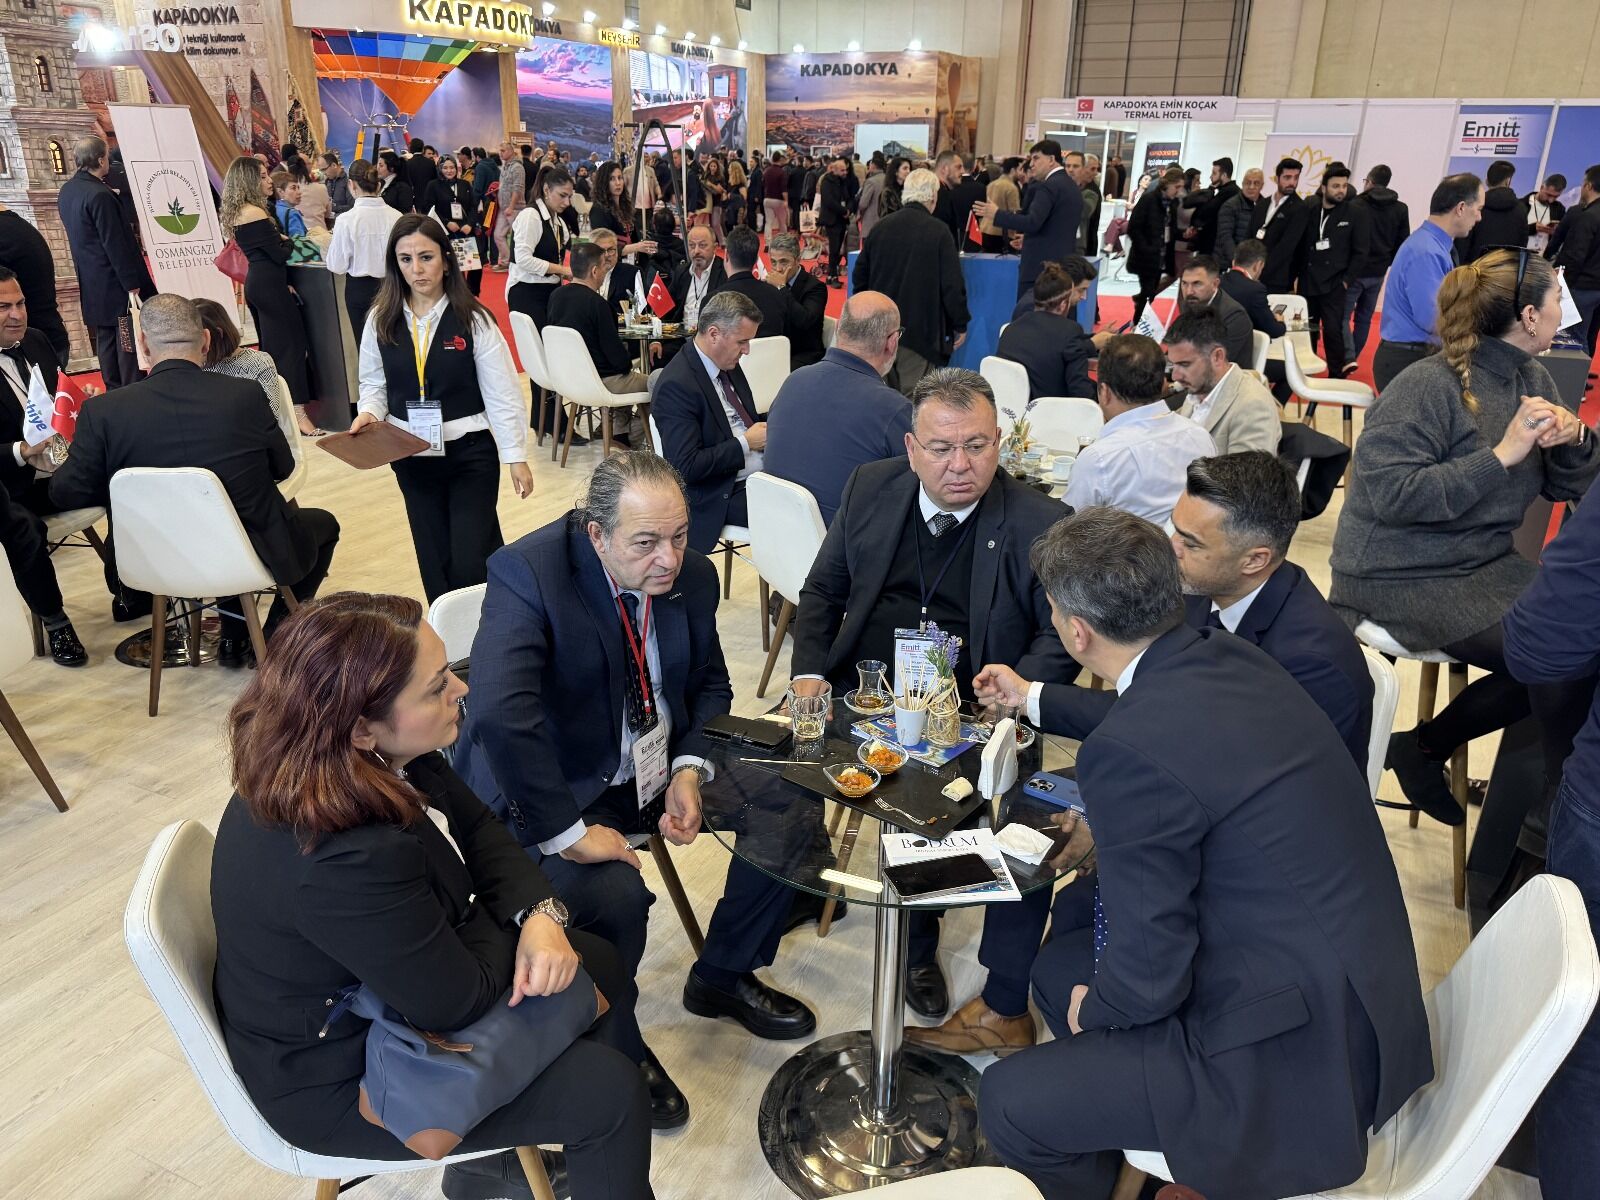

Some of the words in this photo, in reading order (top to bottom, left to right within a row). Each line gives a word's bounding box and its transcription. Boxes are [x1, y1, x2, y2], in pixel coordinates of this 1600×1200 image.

[153, 6, 240, 26] KAPADOKYA
[210, 33, 246, 43] kullanarak
[800, 62, 898, 77] KAPADOKYA
[1103, 101, 1158, 109] KAPADOKYA
[1160, 98, 1183, 109] EMİN
[1184, 101, 1218, 110] KOÇAK
[1124, 111, 1160, 119] TERMAL
[1162, 111, 1193, 119] HOTEL
[1462, 120, 1521, 138] Emitt
[155, 242, 216, 259] OSMANGAZİ
[158, 256, 215, 270] BELEDİYES
